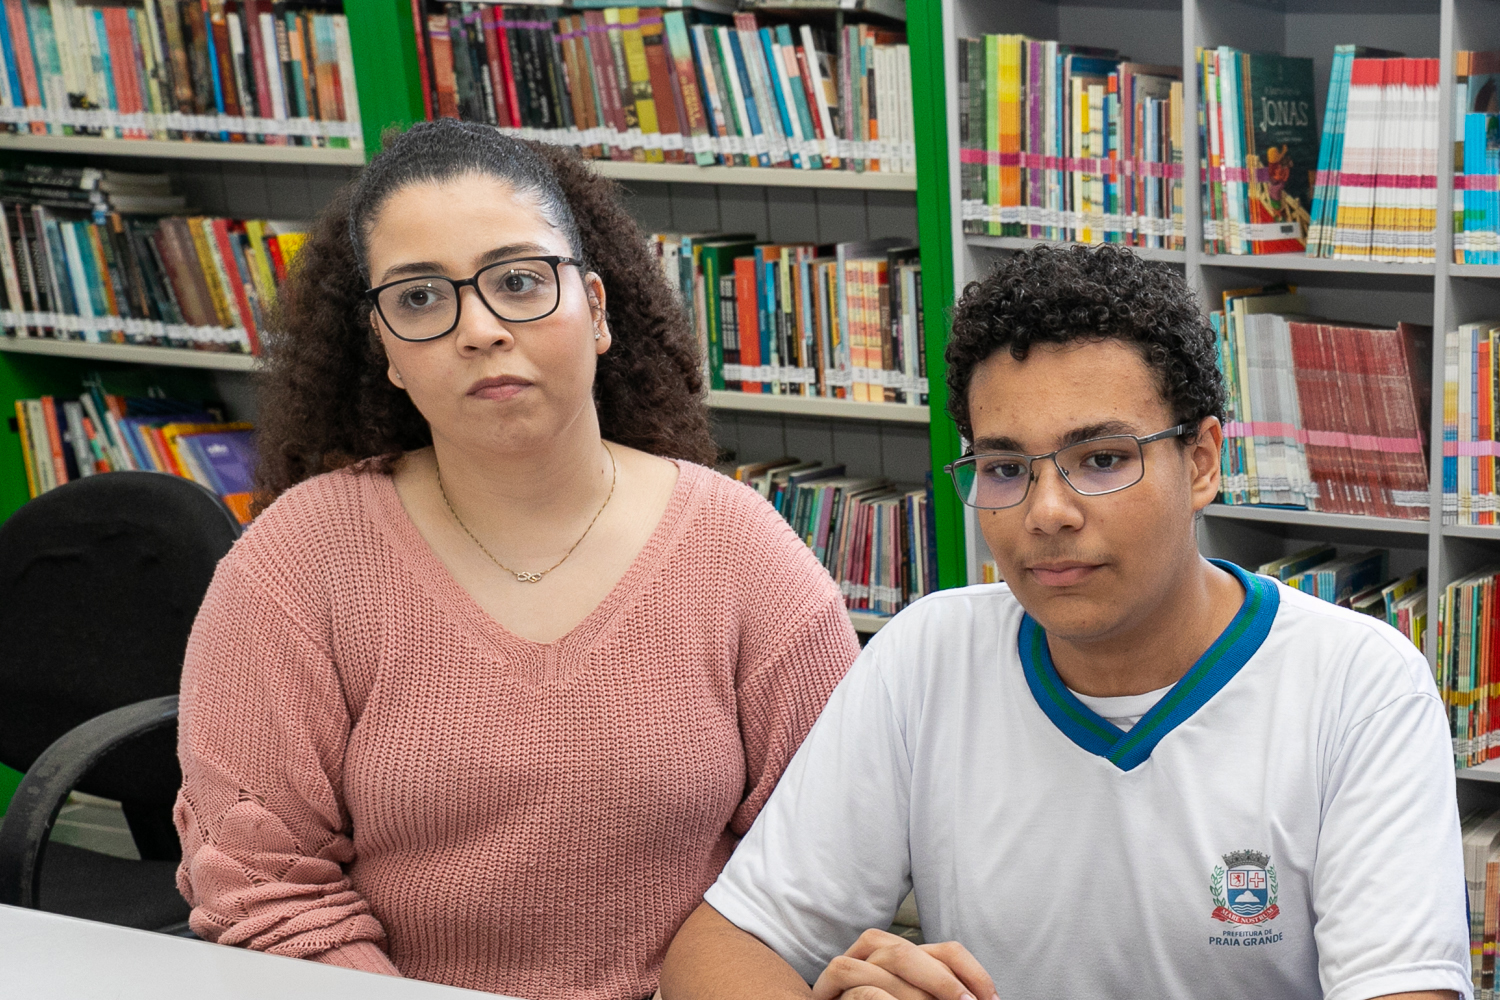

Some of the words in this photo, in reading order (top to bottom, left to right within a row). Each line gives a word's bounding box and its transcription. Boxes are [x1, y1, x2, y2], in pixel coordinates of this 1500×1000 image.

[1259, 96, 1309, 132] JONAS
[1221, 909, 1238, 922] MARE
[1241, 908, 1274, 923] NOSTRUM
[1209, 937, 1240, 946] PRAIA
[1243, 932, 1283, 946] GRANDE
